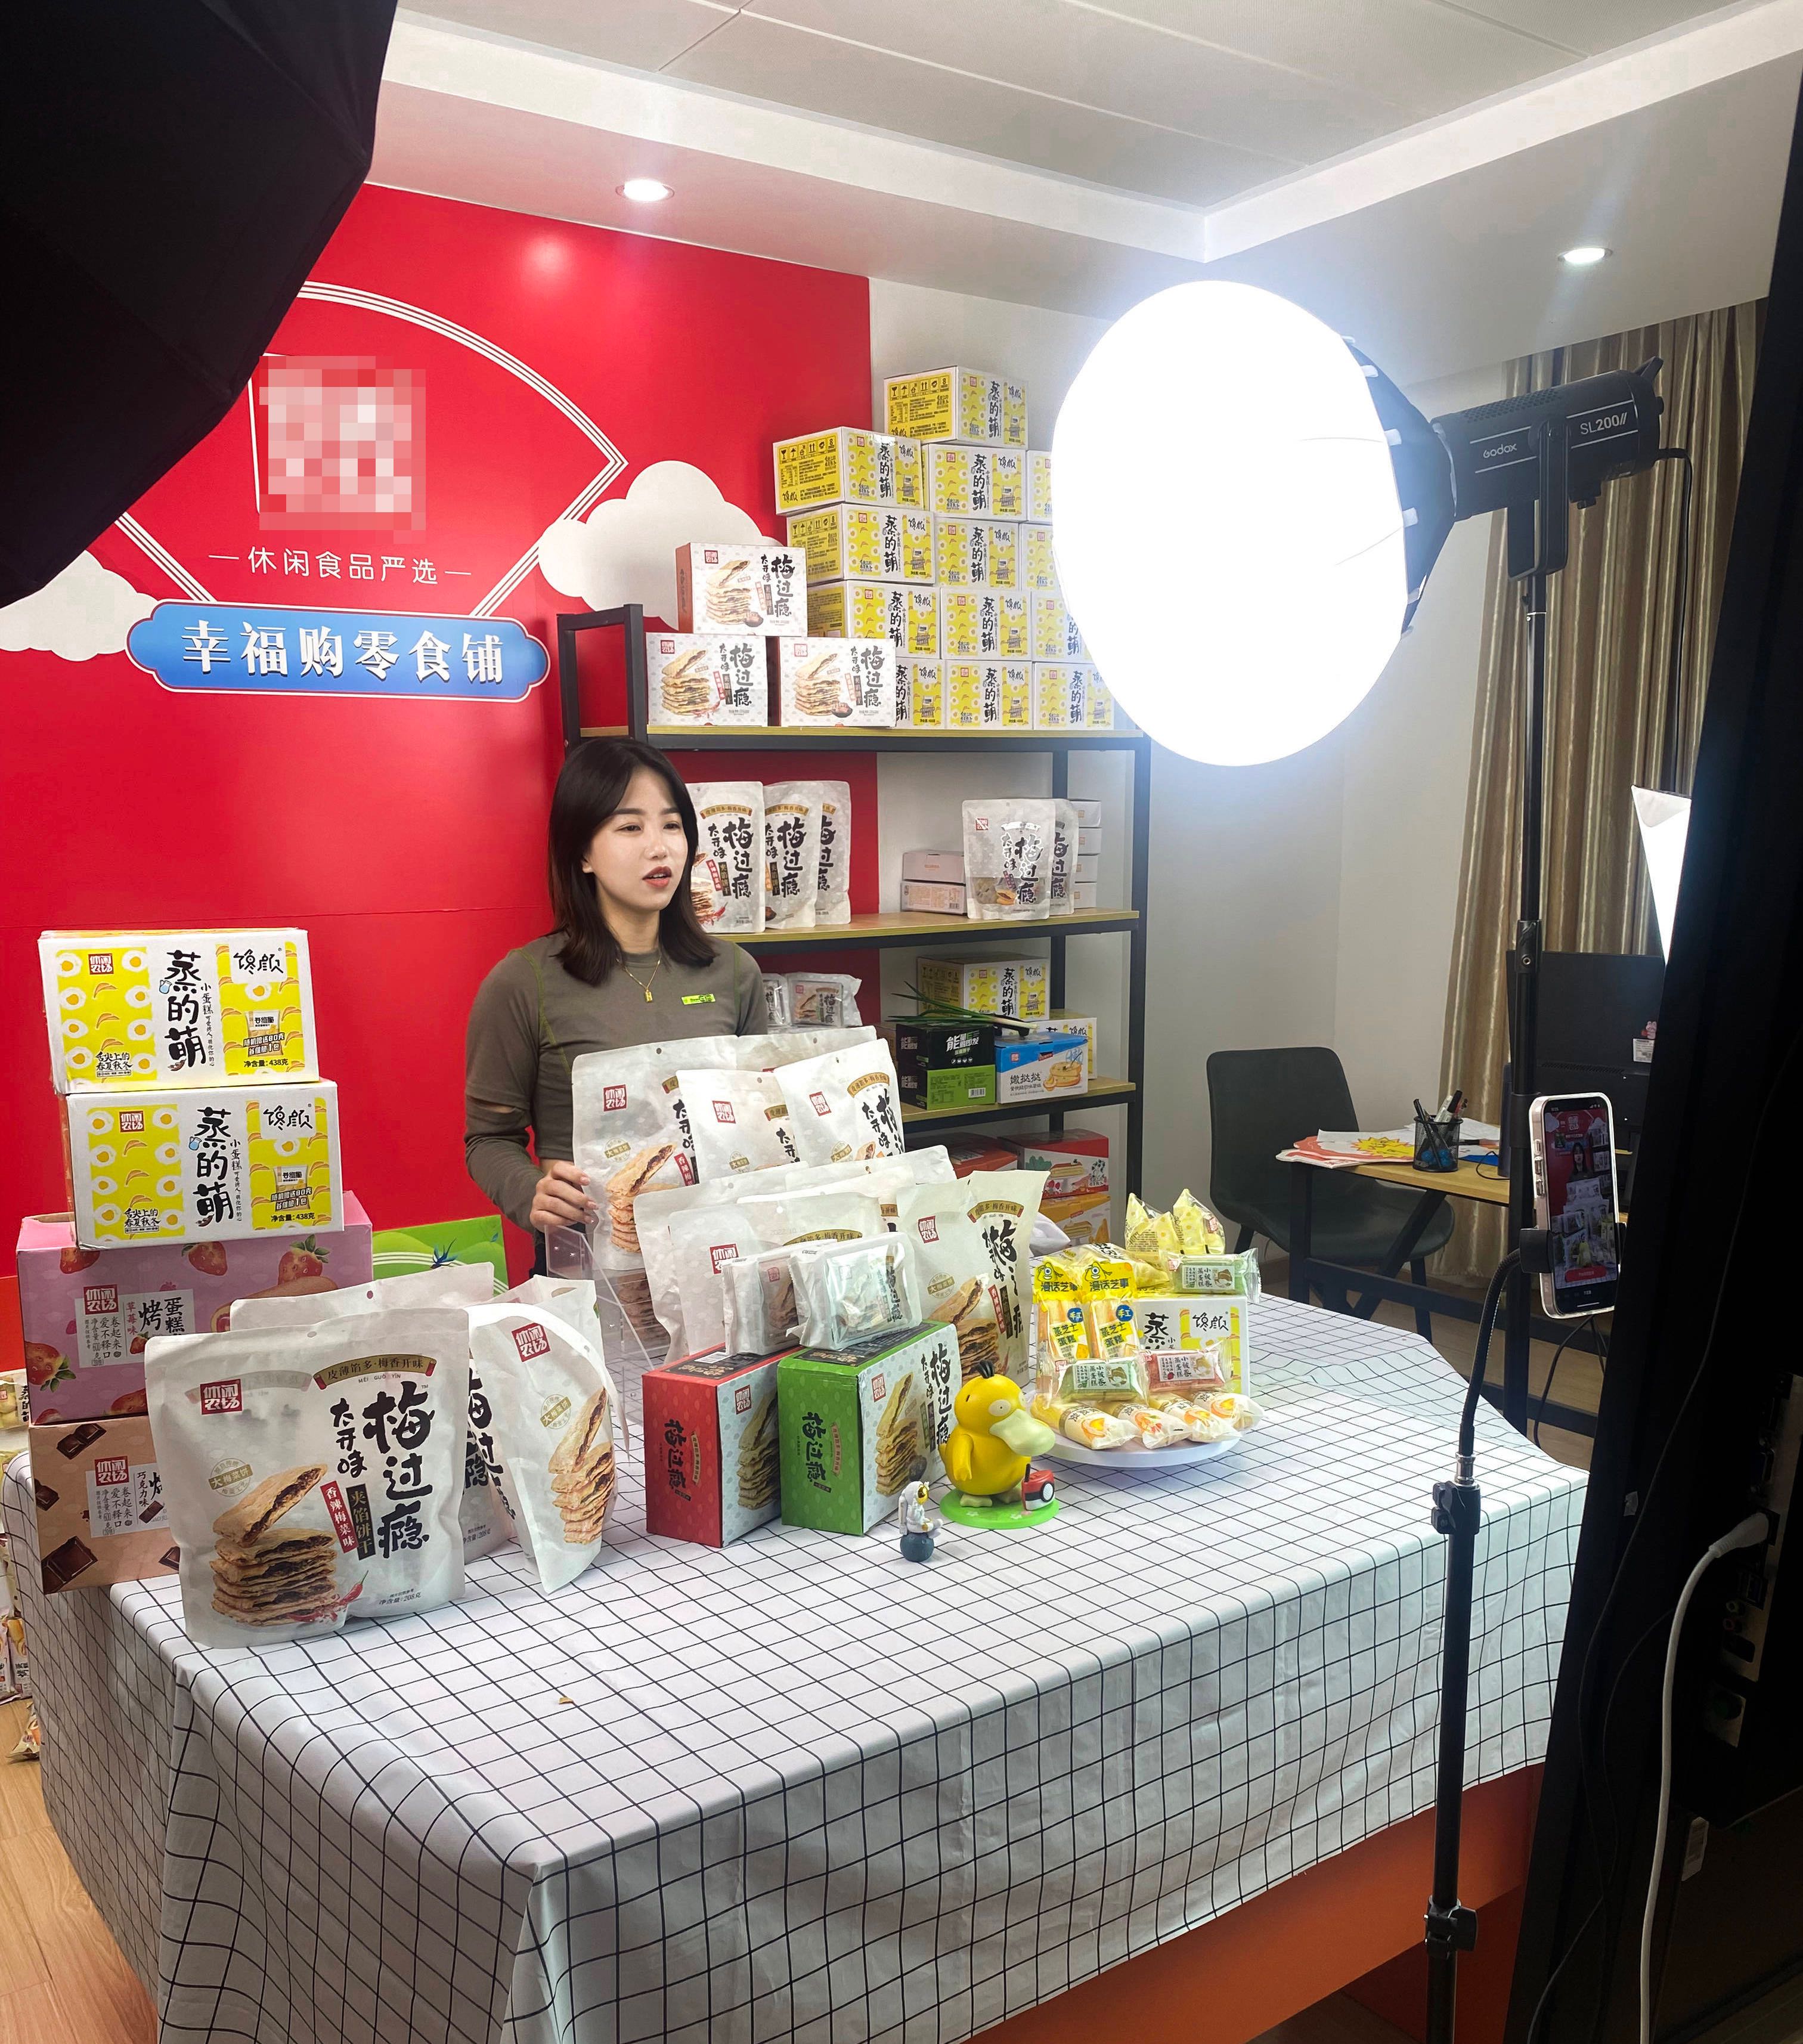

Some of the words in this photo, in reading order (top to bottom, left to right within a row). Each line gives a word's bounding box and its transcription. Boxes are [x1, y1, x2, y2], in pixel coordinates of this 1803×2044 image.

[988, 380, 1000, 438] 蒸的萌
[879, 443, 891, 498] 蒸的萌
[1483, 443, 1517, 459] Godox
[972, 453, 987, 510] 蒸的萌
[247, 546, 438, 585] 休闲食品严选
[884, 515, 898, 574] 蒸的萌
[971, 527, 984, 583] 蒸的萌
[771, 554, 795, 618] 梅过瘾
[889, 591, 904, 648] 蒸的萌
[981, 596, 995, 652] 蒸的萌
[181, 620, 504, 684] 幸福购零食铺
[730, 643, 755, 707] 梅过瘾
[860, 645, 885, 708] 梅过瘾
[896, 665, 909, 722] 蒸的萌
[984, 667, 997, 723] 蒸的萌
[1070, 671, 1083, 723] 蒸的萌
[723, 817, 754, 899] 梅过瘾
[777, 816, 807, 898] 梅过瘾
[1014, 834, 1043, 905] 梅过瘾
[165, 949, 206, 1067] 蒸的萌
[201, 983, 213, 1014] 小蛋糕
[1001, 968, 1015, 1015] 蒸的萌
[96, 1051, 130, 1061] 舌尖上的
[96, 1061, 133, 1071] 春夏秋冬
[1010, 1073, 1041, 1085] 嫩挞挞
[193, 1106, 234, 1223] 蒸的萌
[230, 1139, 243, 1170] 小蛋糕
[125, 1207, 159, 1218] 舌尖上的
[125, 1217, 162, 1227] 春夏秋冬
[100, 1317, 111, 1358] 爱不释口
[111, 1316, 122, 1351] 卷起来
[126, 1302, 138, 1336] 草莓味
[138, 1300, 163, 1331] 烤
[1117, 1309, 1131, 1318] 手工
[1144, 1312, 1169, 1349] 蒸
[203, 1383, 239, 1399] 休闲
[328, 1357, 424, 1380] 皮薄馅多·梅香开味
[205, 1397, 240, 1411] 农场
[930, 1343, 952, 1445] 梅过瘾
[97, 1459, 126, 1473] 休闲
[362, 1381, 435, 1559] 梅过瘾
[664, 1419, 687, 1489] 梅过瘾
[802, 1412, 826, 1482] 梅过瘾
[98, 1470, 128, 1484] 农场
[137, 1471, 150, 1507] 巧克力味
[210, 1466, 250, 1488] 大梅菜饼
[111, 1487, 122, 1528] 爱不释口
[122, 1486, 133, 1519] 卷起来
[326, 1486, 355, 1547] 香辣梅菜味
[351, 1490, 373, 1554] 夹馅饼干
